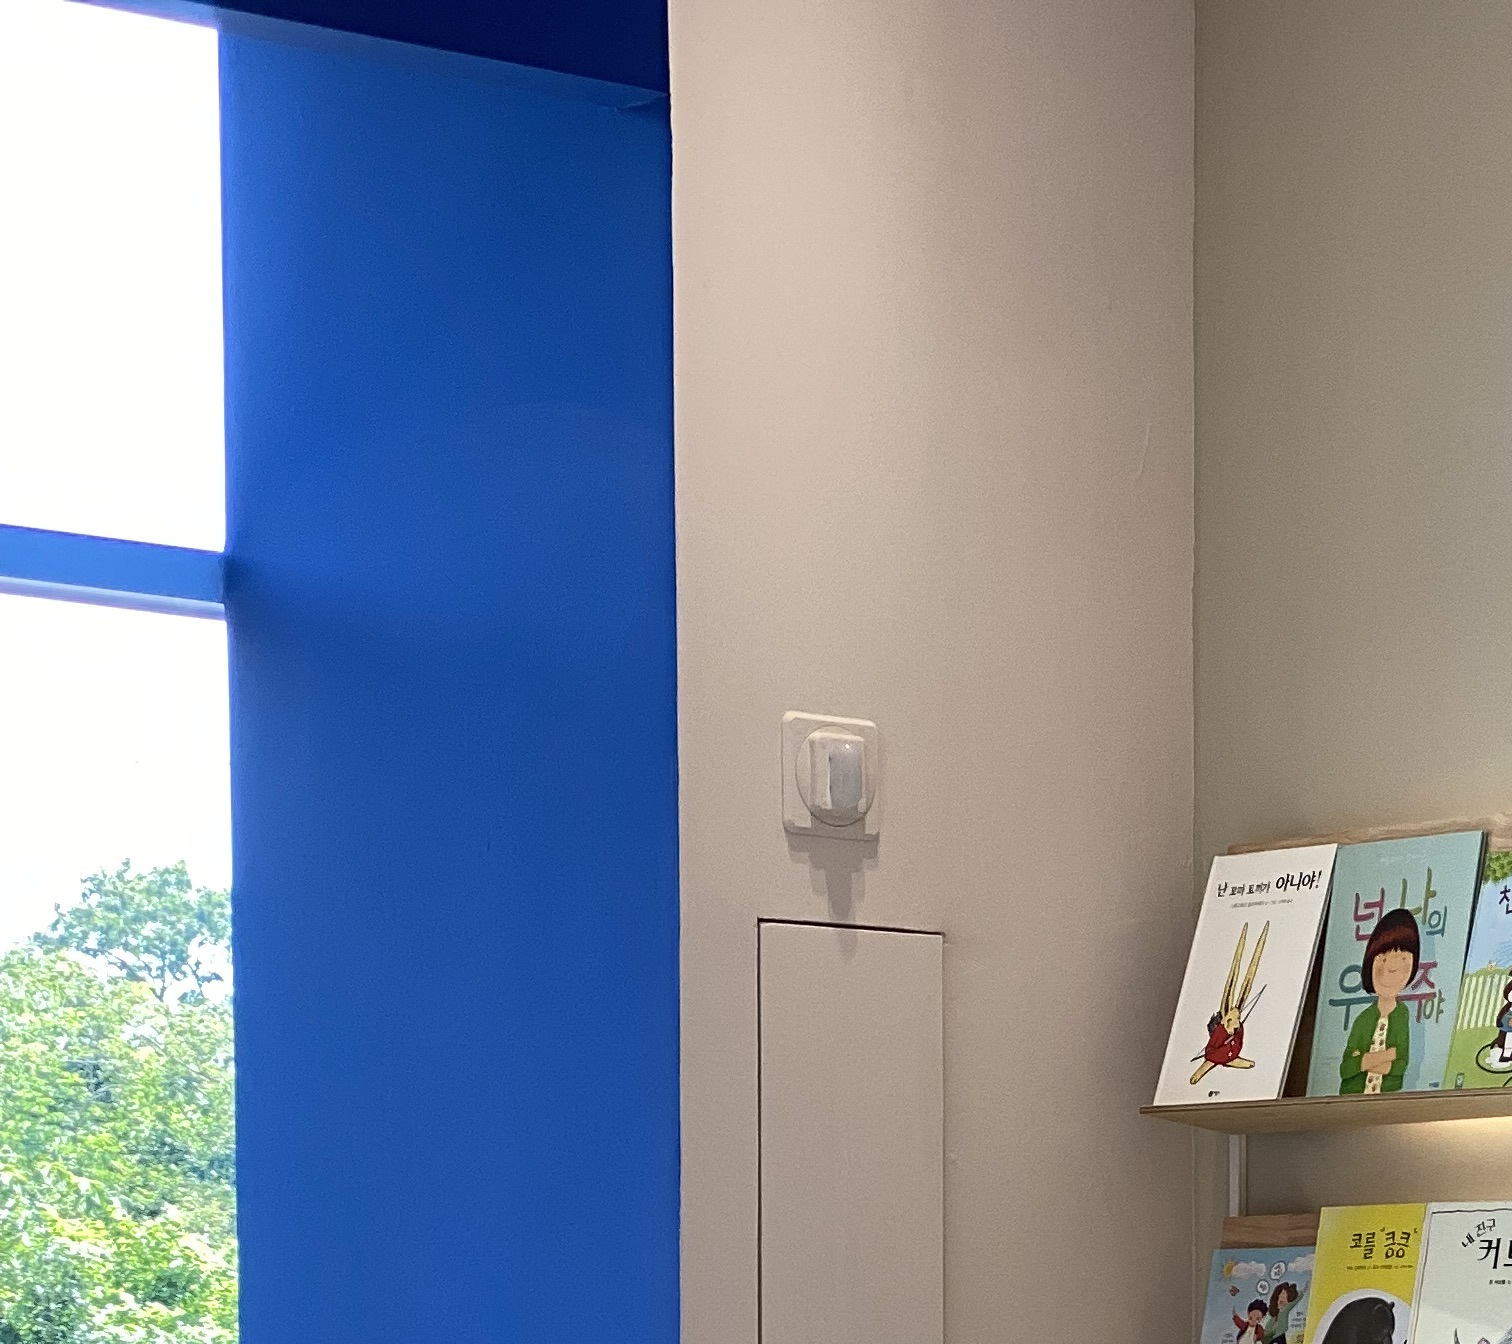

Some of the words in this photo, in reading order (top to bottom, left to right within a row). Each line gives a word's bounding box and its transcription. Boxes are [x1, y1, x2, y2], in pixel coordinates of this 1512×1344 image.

[1217, 882, 1228, 897] 난
[1276, 870, 1322, 892] 아니야!
[1350, 1231, 1376, 1259] 코를
[1461, 1232, 1476, 1248] 내
[1475, 1218, 1497, 1238] 친구
